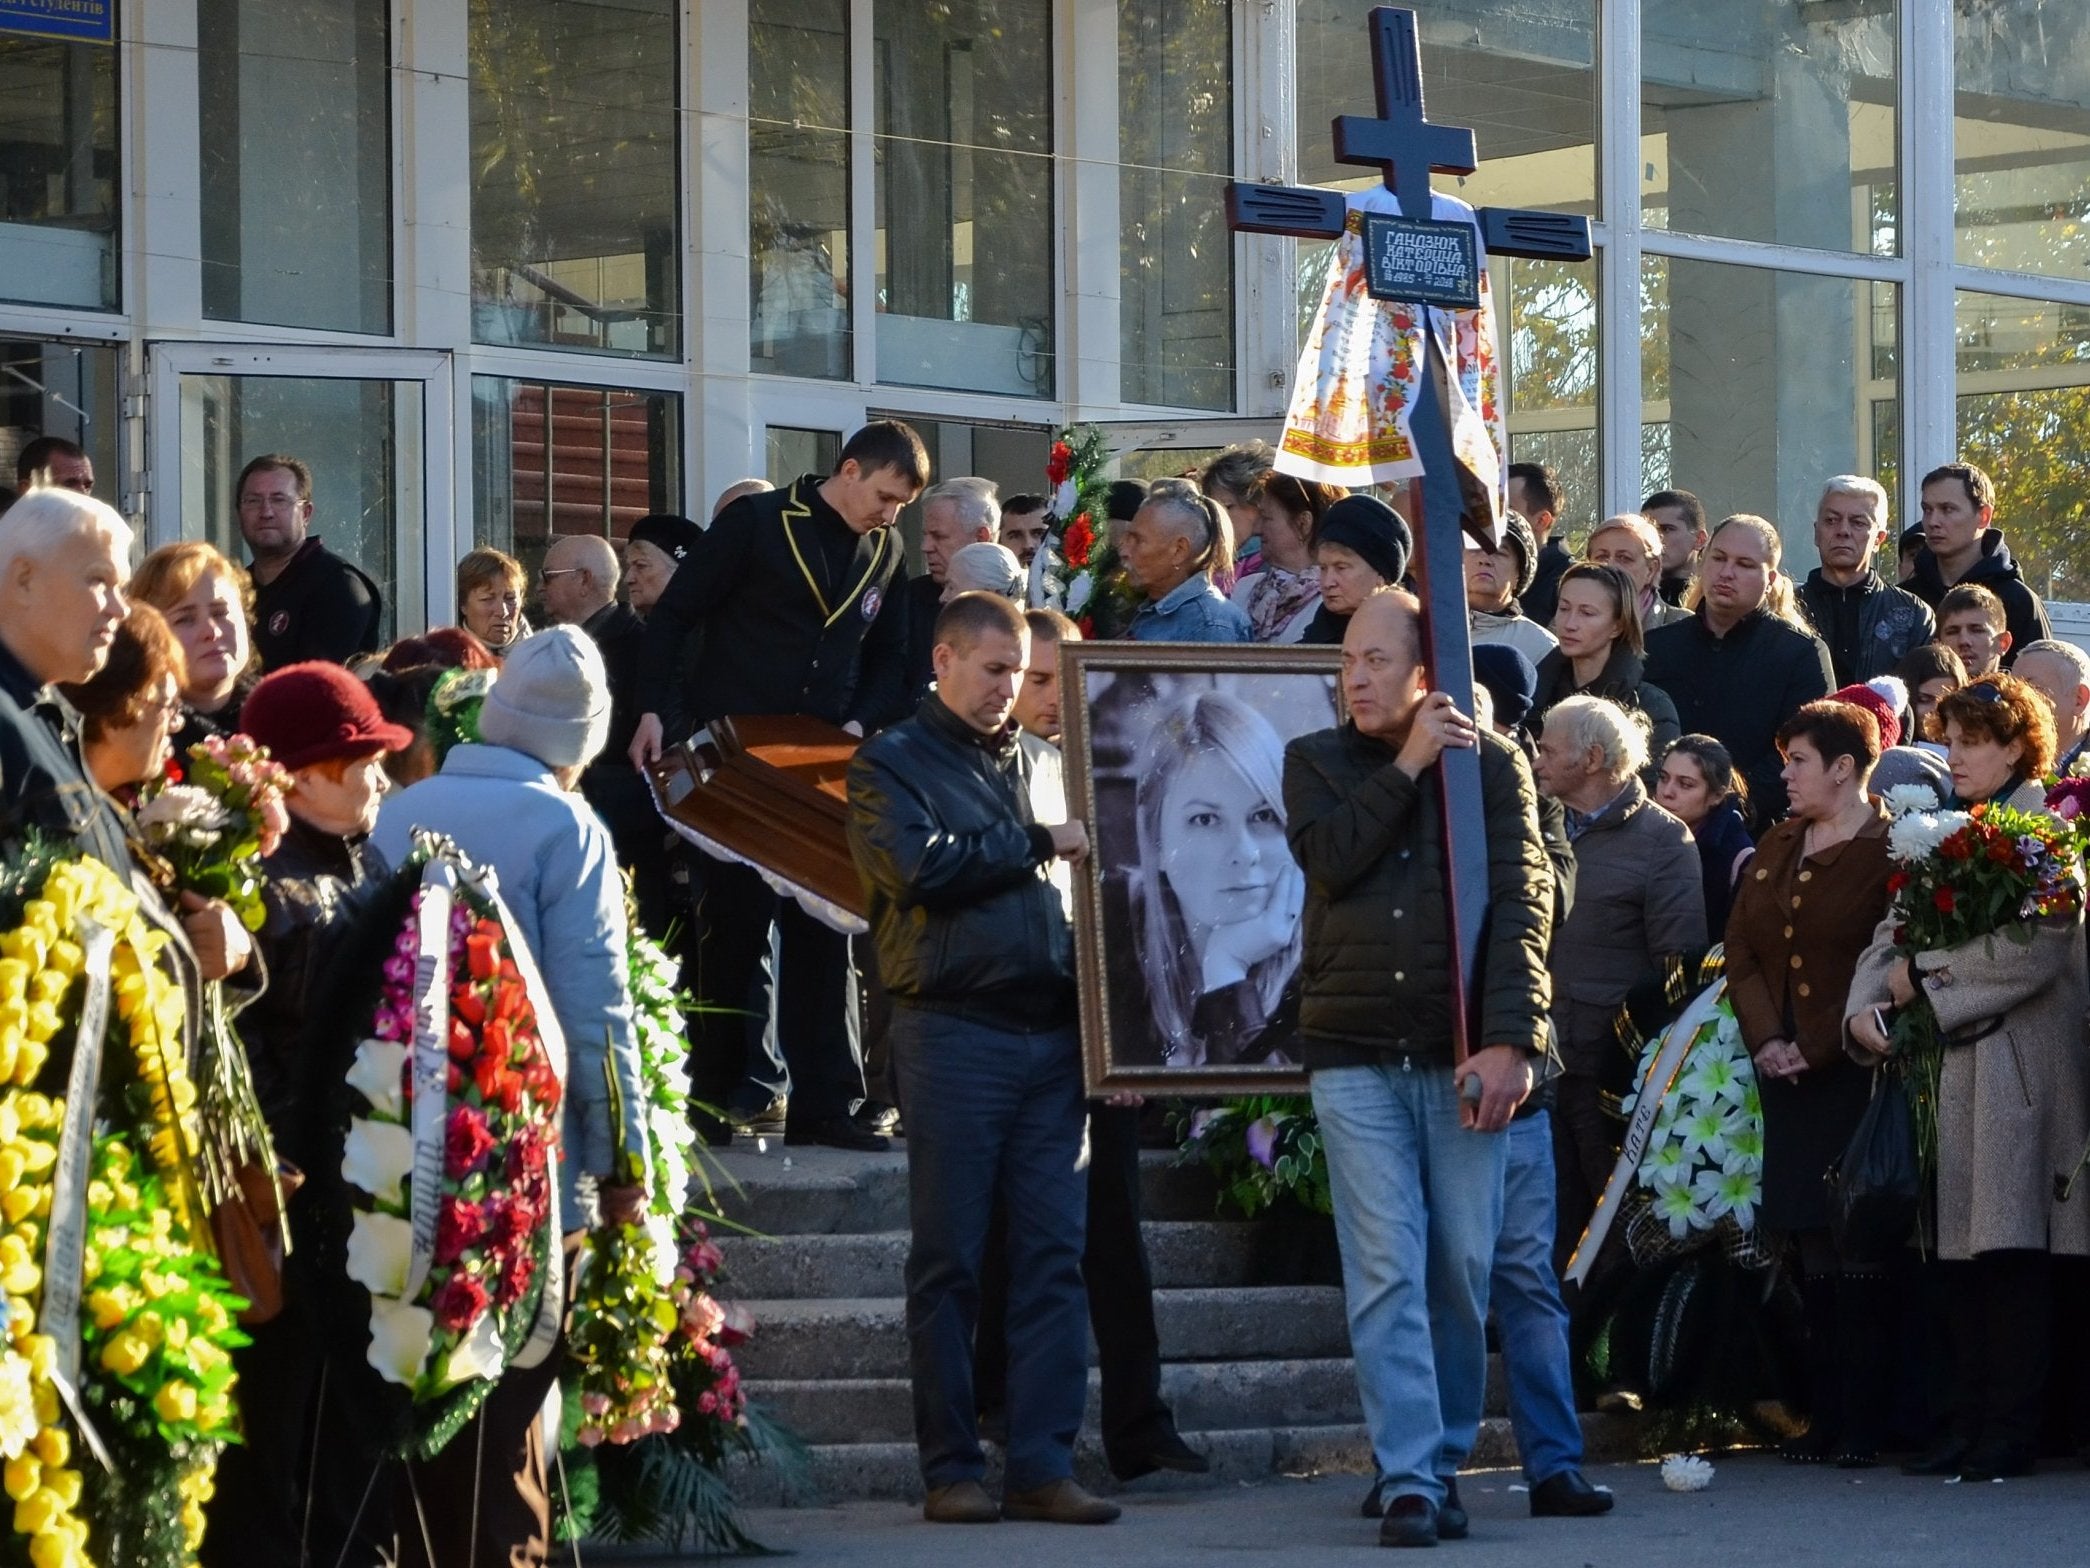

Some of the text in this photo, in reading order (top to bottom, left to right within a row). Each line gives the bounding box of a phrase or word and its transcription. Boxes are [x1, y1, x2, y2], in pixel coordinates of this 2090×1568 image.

[1385, 231, 1460, 251] ГАНДЗЮК
[1386, 244, 1462, 264] КАТЕРИНА
[1381, 256, 1466, 276] ВІКТОРІВНА
